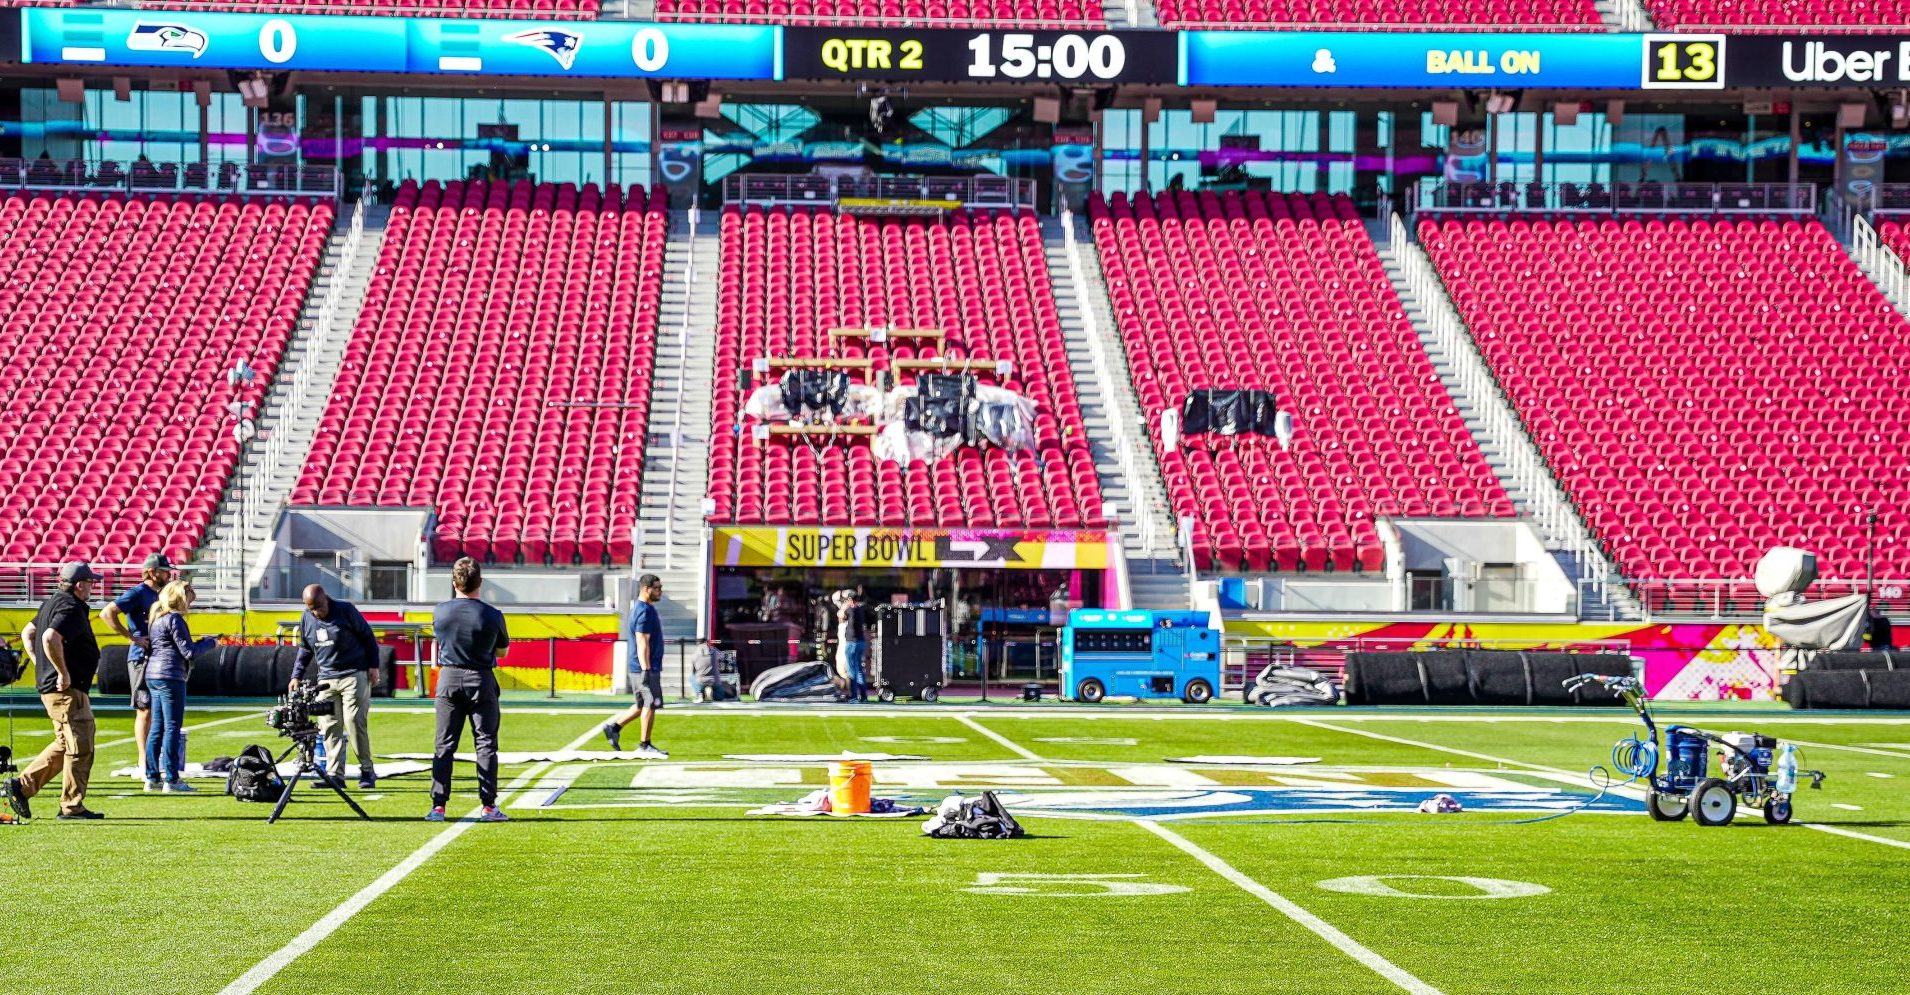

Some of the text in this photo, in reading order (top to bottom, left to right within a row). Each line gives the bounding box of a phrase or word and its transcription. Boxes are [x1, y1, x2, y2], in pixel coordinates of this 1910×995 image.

[258, 19, 297, 63] 0
[631, 27, 670, 72] 0
[821, 39, 923, 72] QTR 2
[967, 33, 1126, 80] 15:00
[1311, 48, 1337, 74] &
[1426, 50, 1541, 75] BALL ON
[1656, 42, 1716, 81] 13
[1781, 41, 1892, 82] Uber
[788, 534, 1025, 562] SUPER BOWL LX
[1878, 586, 1903, 599] 140
